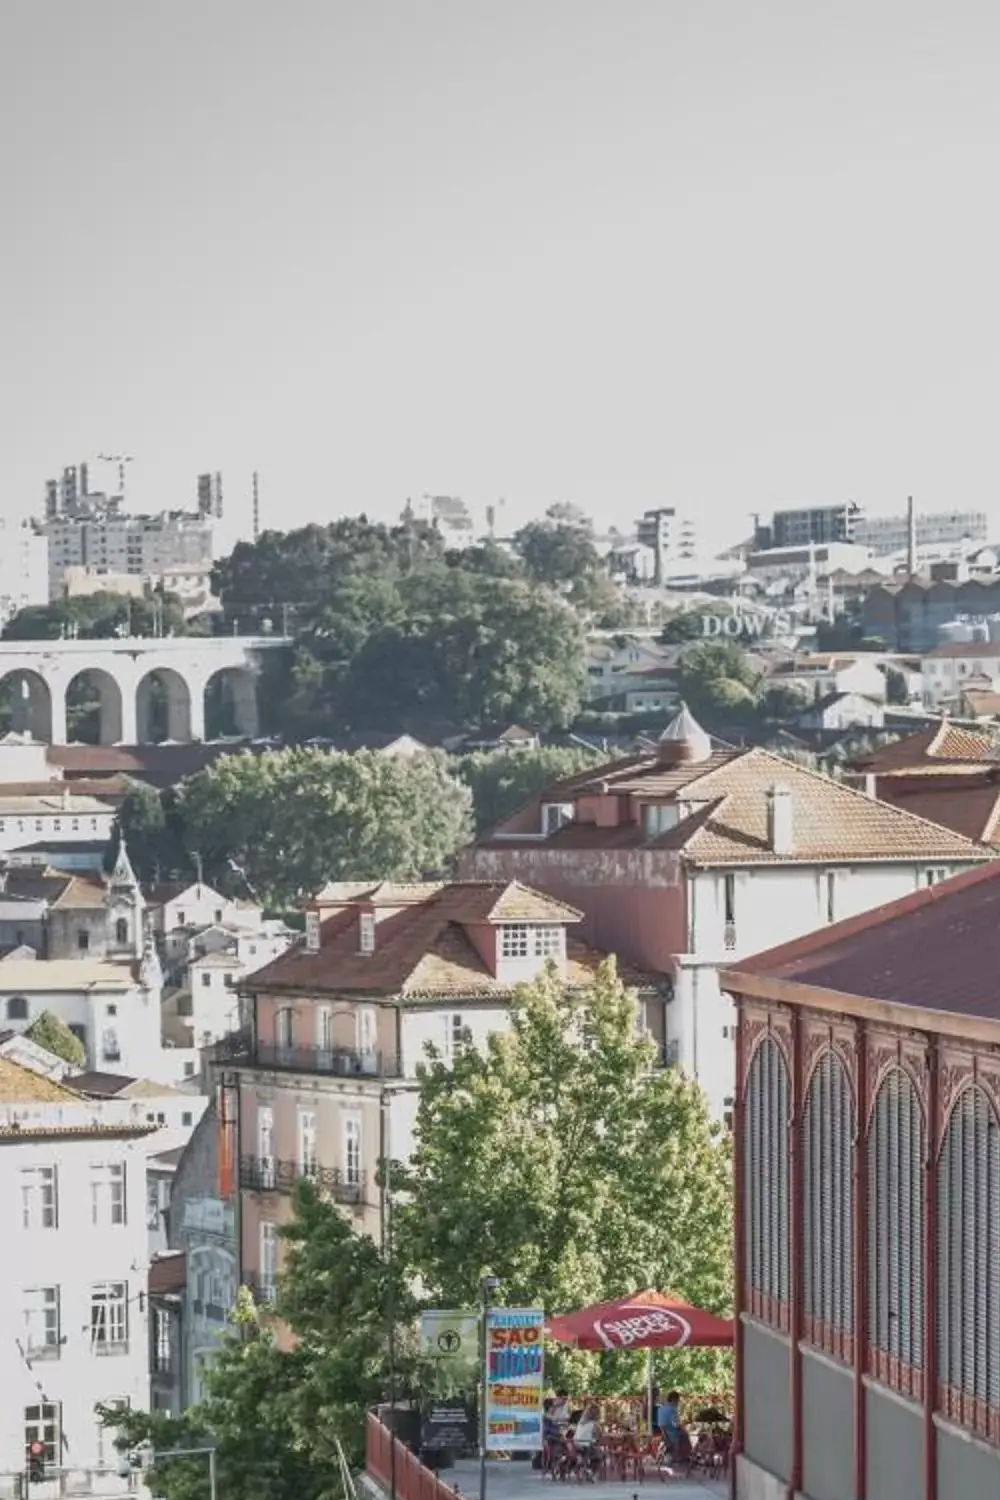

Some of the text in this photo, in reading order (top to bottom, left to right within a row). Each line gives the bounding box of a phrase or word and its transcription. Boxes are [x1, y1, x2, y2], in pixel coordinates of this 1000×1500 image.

[701, 612, 792, 637] DOW'S
[603, 1312, 669, 1333] SUPER
[619, 1320, 679, 1346] BOCK
